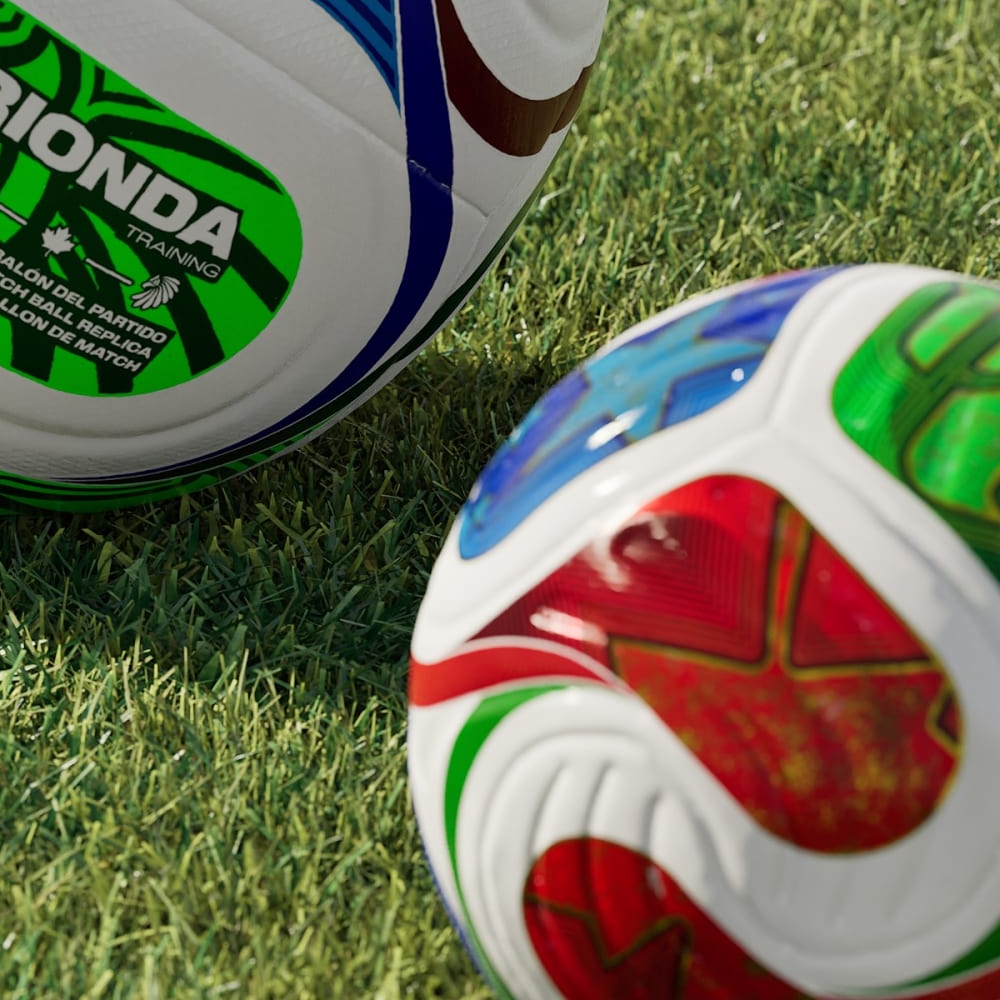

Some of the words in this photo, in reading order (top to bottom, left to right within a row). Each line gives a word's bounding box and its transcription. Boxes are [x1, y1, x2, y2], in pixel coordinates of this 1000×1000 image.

[127, 224, 221, 278] TRAINING
[28, 293, 74, 325] BALL
[76, 319, 153, 359] REPLICA
[52, 285, 86, 310] DEL
[88, 303, 167, 344] PARTIDO
[47, 325, 76, 345] DE
[74, 338, 142, 372] MATCH
